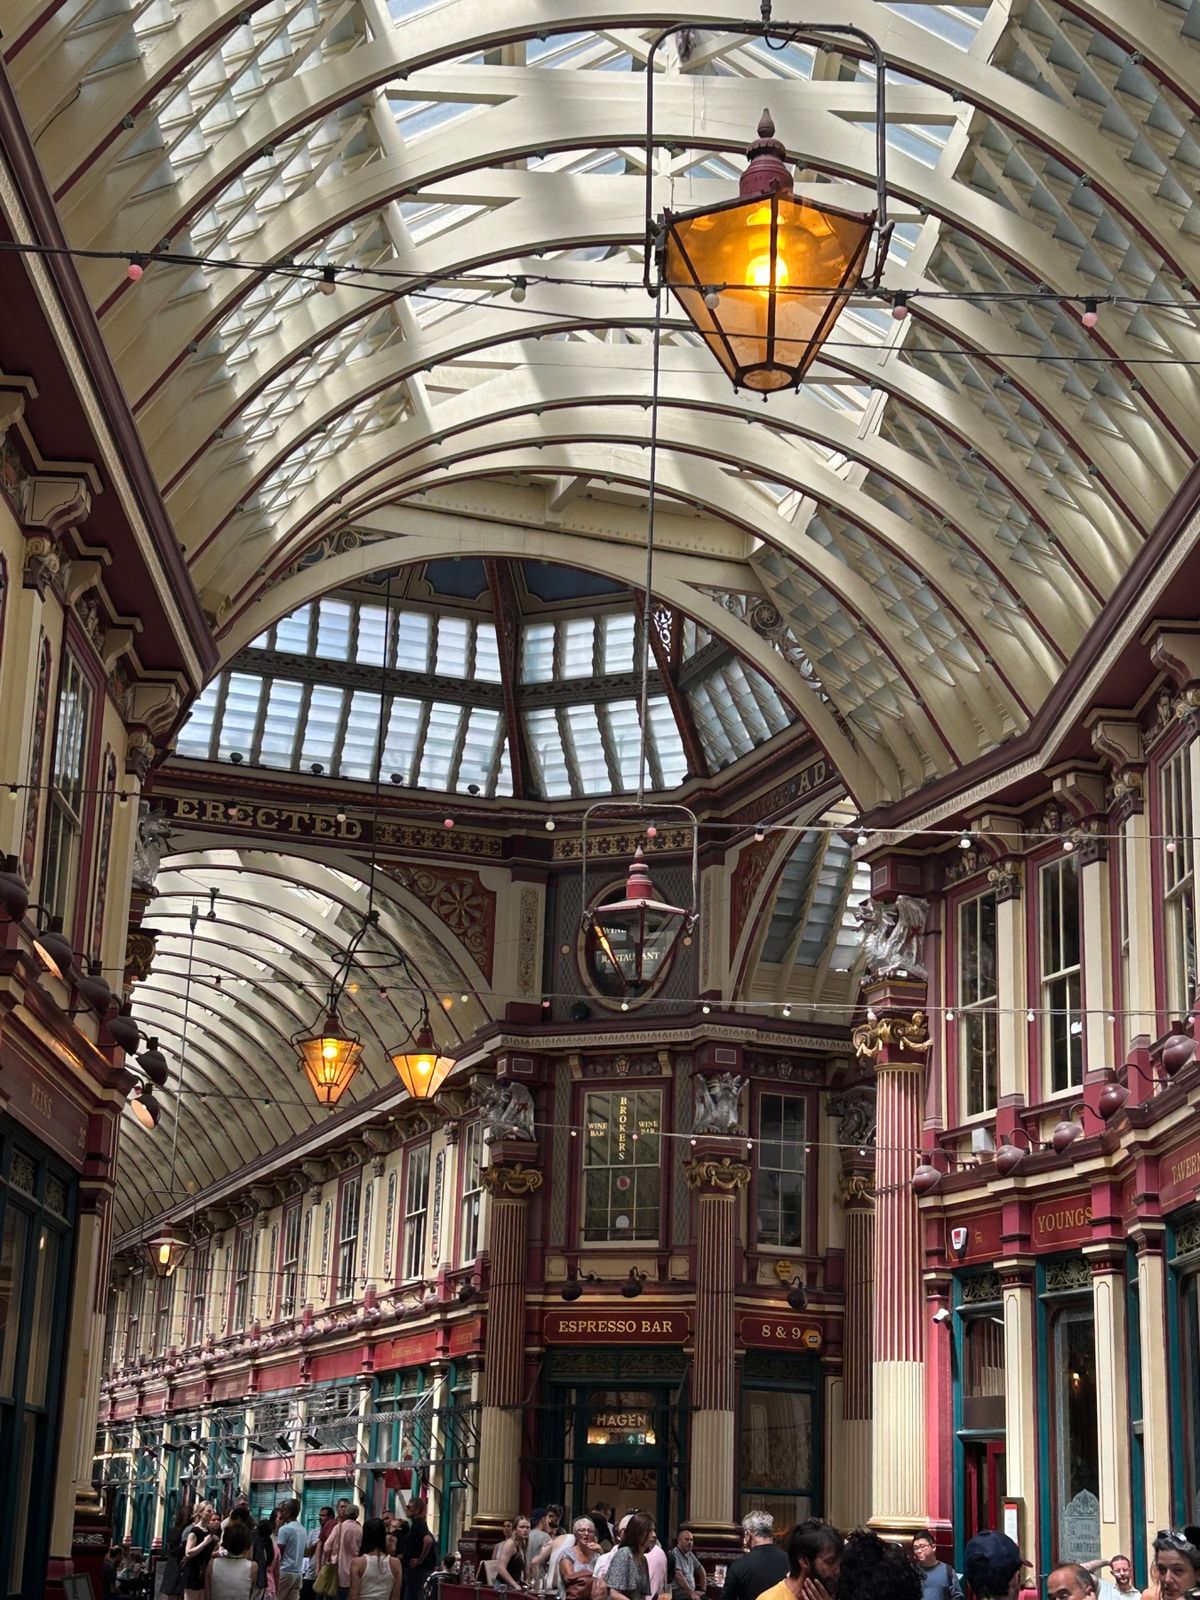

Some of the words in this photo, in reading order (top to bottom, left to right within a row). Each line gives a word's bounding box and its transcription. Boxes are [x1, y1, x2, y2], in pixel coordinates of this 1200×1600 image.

[173, 799, 363, 840] ERECTED
[588, 1122, 608, 1130] WINE
[618, 1096, 628, 1161] BROKERS
[638, 1120, 659, 1129] WINE
[558, 1320, 637, 1333] ESPRESSO
[640, 1320, 673, 1333] BAR
[761, 1324, 771, 1338] 8
[775, 1326, 788, 1339] &
[791, 1327, 801, 1340] 9
[596, 1414, 646, 1427] HAGEN
